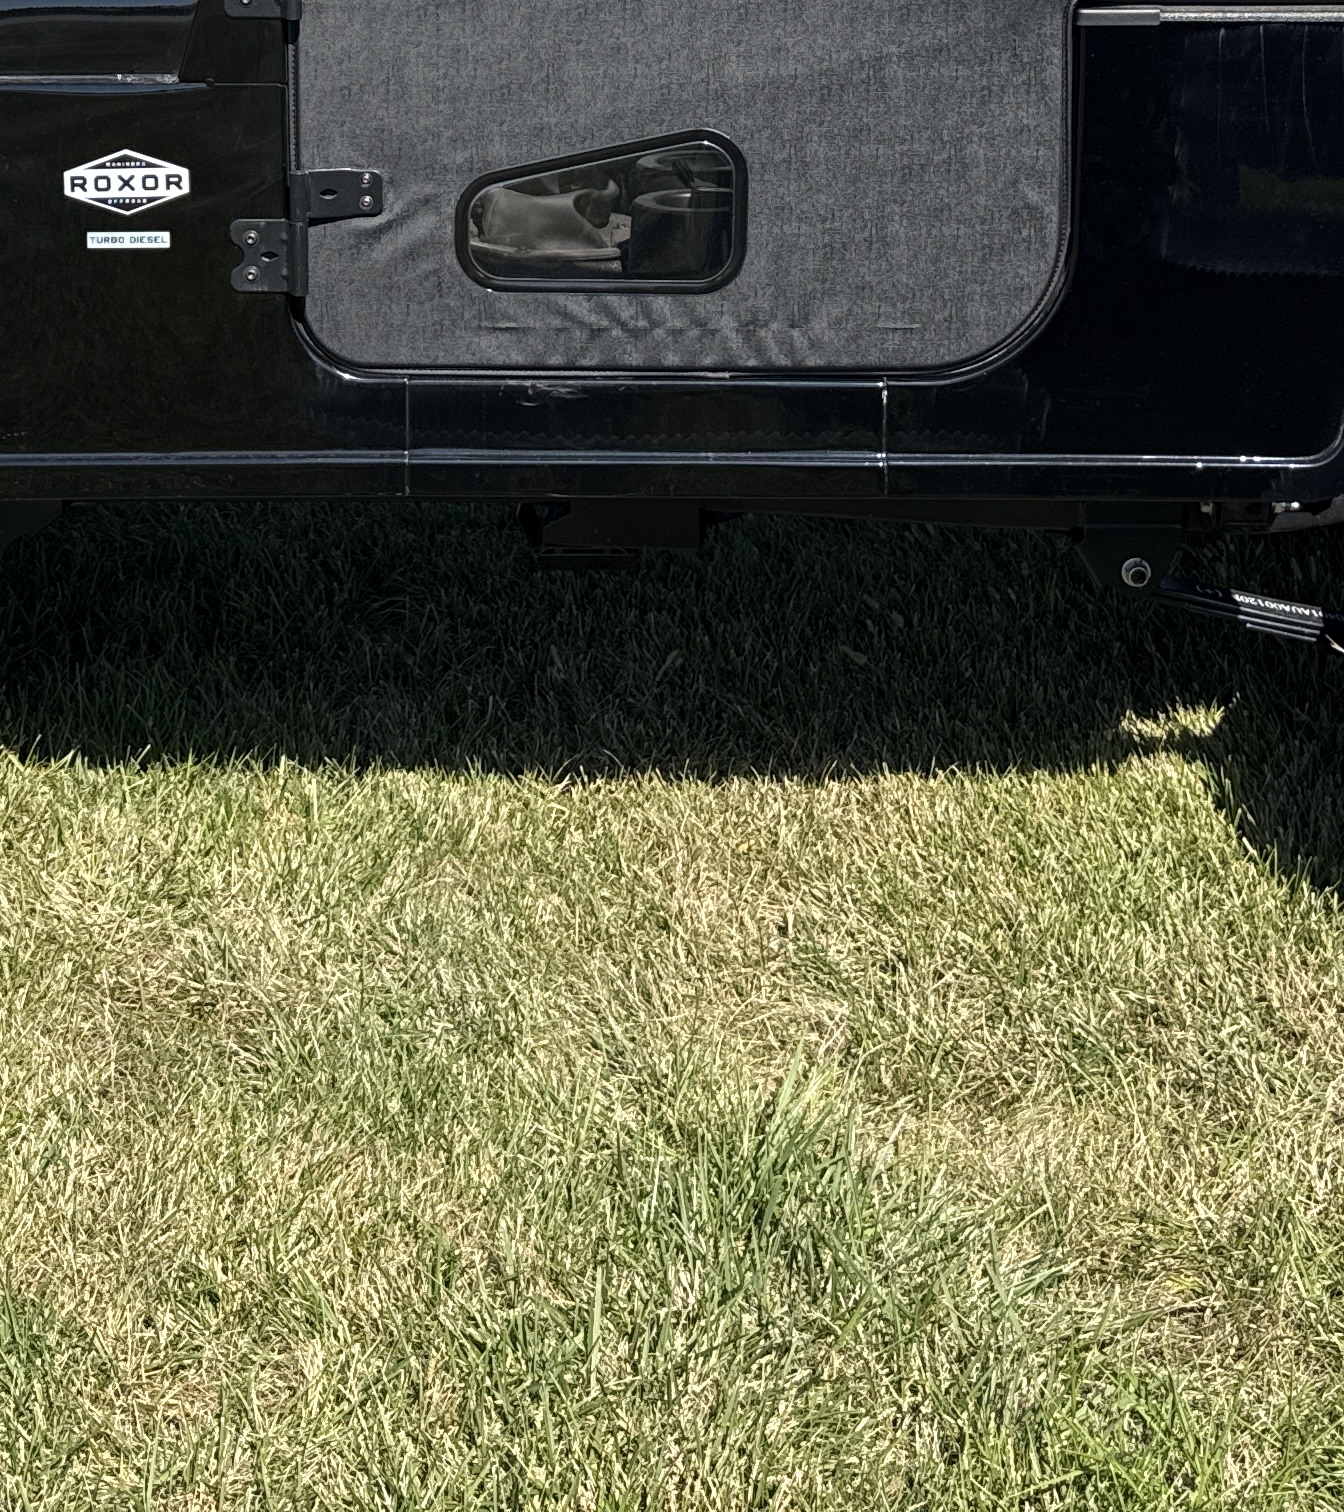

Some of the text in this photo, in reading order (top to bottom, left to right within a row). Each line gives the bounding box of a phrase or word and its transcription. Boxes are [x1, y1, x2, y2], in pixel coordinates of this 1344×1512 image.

[70, 174, 183, 192] ROXOR
[89, 235, 168, 244] TURBO DIESEL
